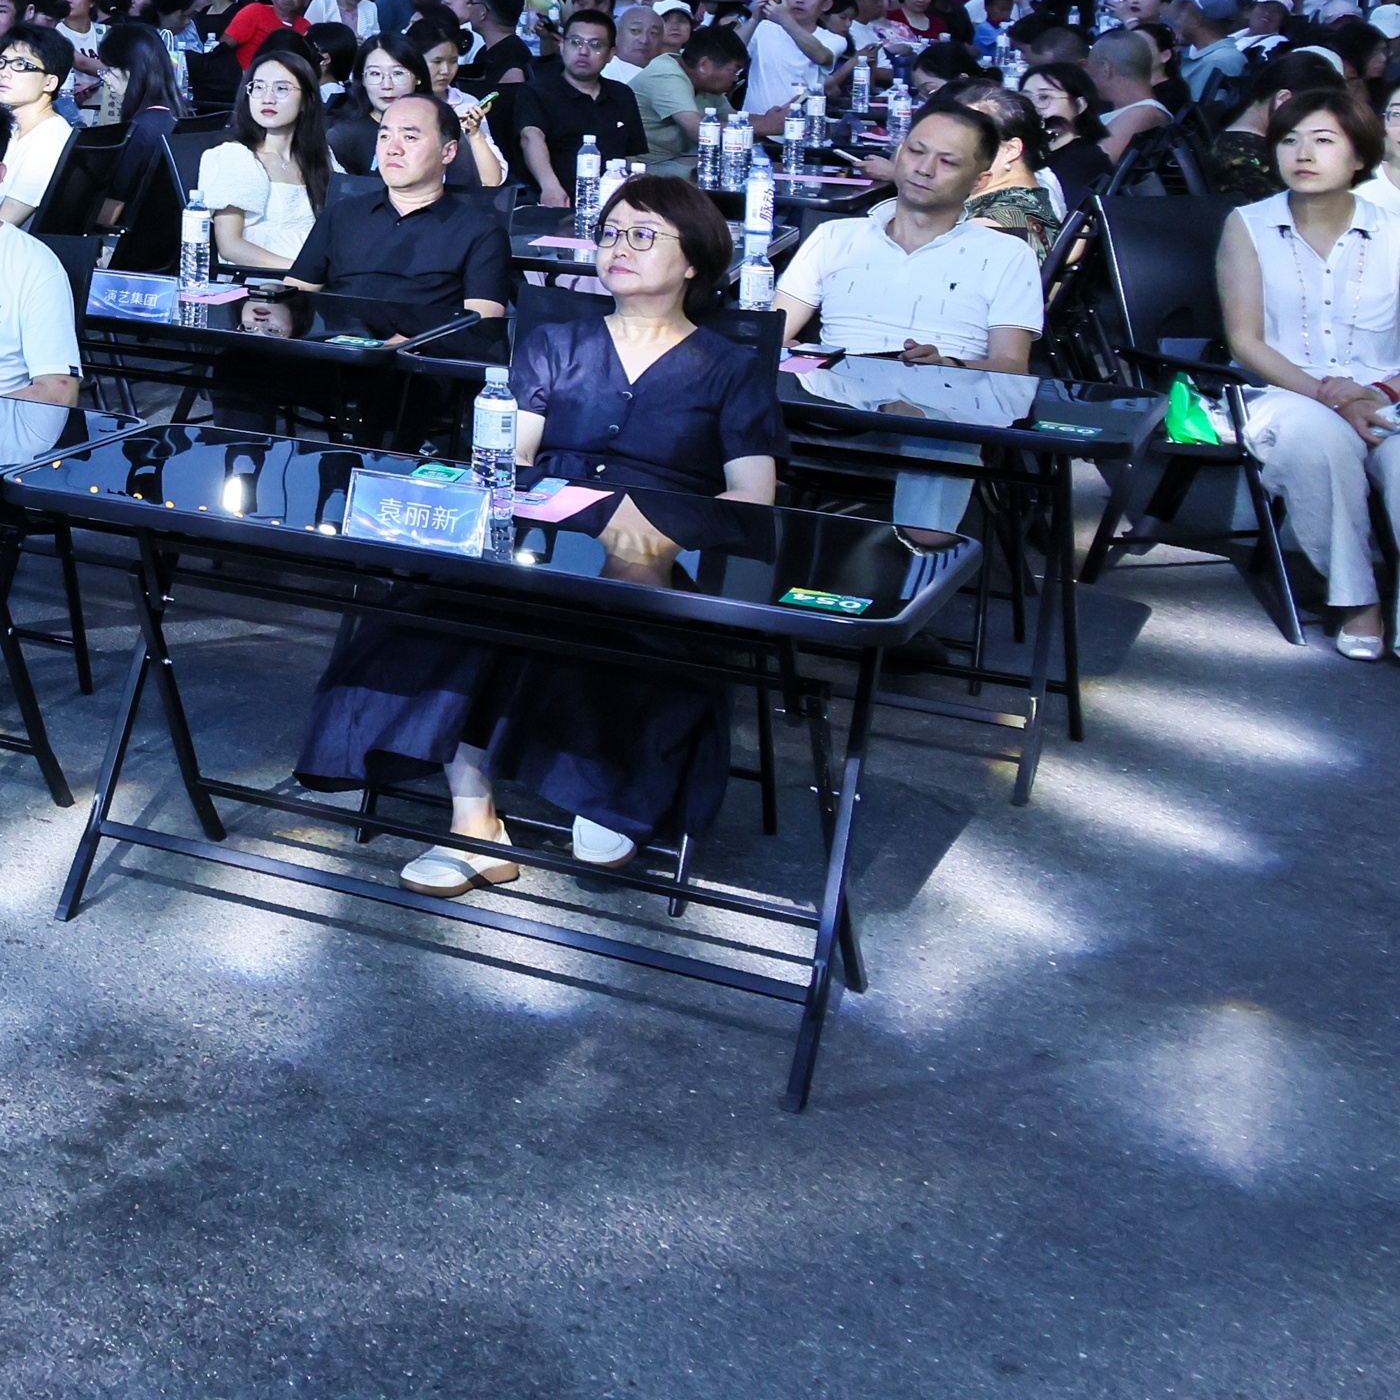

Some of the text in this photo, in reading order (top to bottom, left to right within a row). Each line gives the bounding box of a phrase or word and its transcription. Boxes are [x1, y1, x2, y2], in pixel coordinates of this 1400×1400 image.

[104, 288, 159, 307] 演艺集团
[376, 496, 459, 534] 袁丽新
